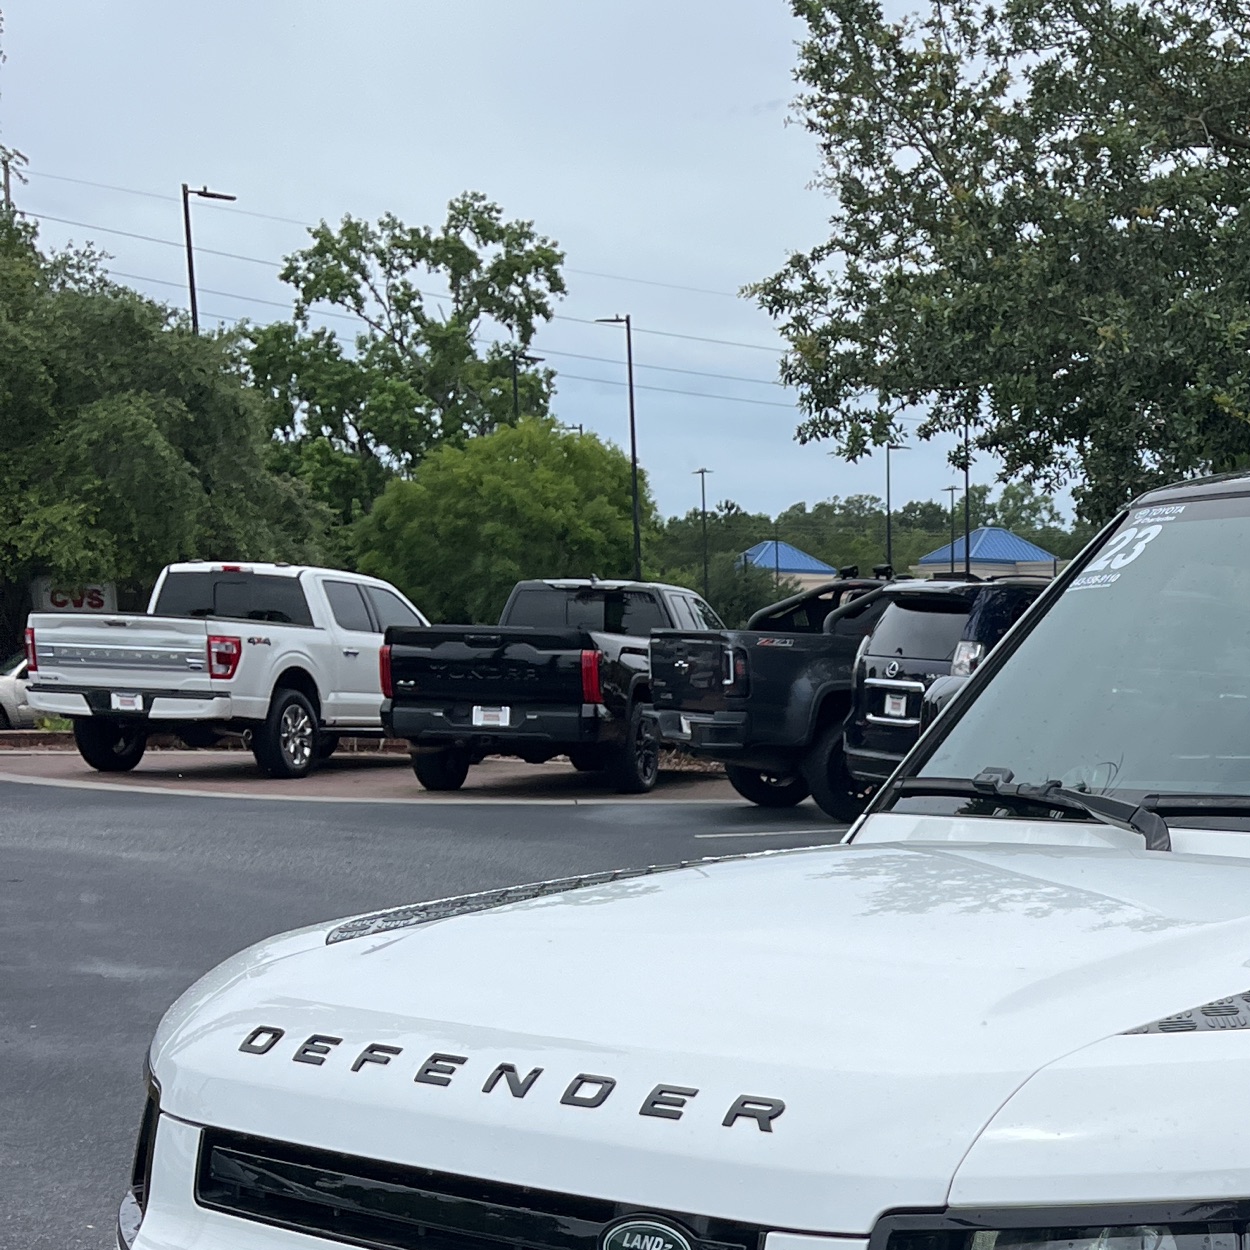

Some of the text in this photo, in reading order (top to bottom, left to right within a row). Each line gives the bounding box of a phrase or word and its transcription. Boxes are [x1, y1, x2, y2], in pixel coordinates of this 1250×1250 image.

[1148, 505, 1186, 517] TOYOTA
[1082, 524, 1163, 574] 23
[50, 588, 104, 609] CVS
[60, 648, 179, 661] PLATINUM
[237, 1024, 787, 1134] DEFENDER
